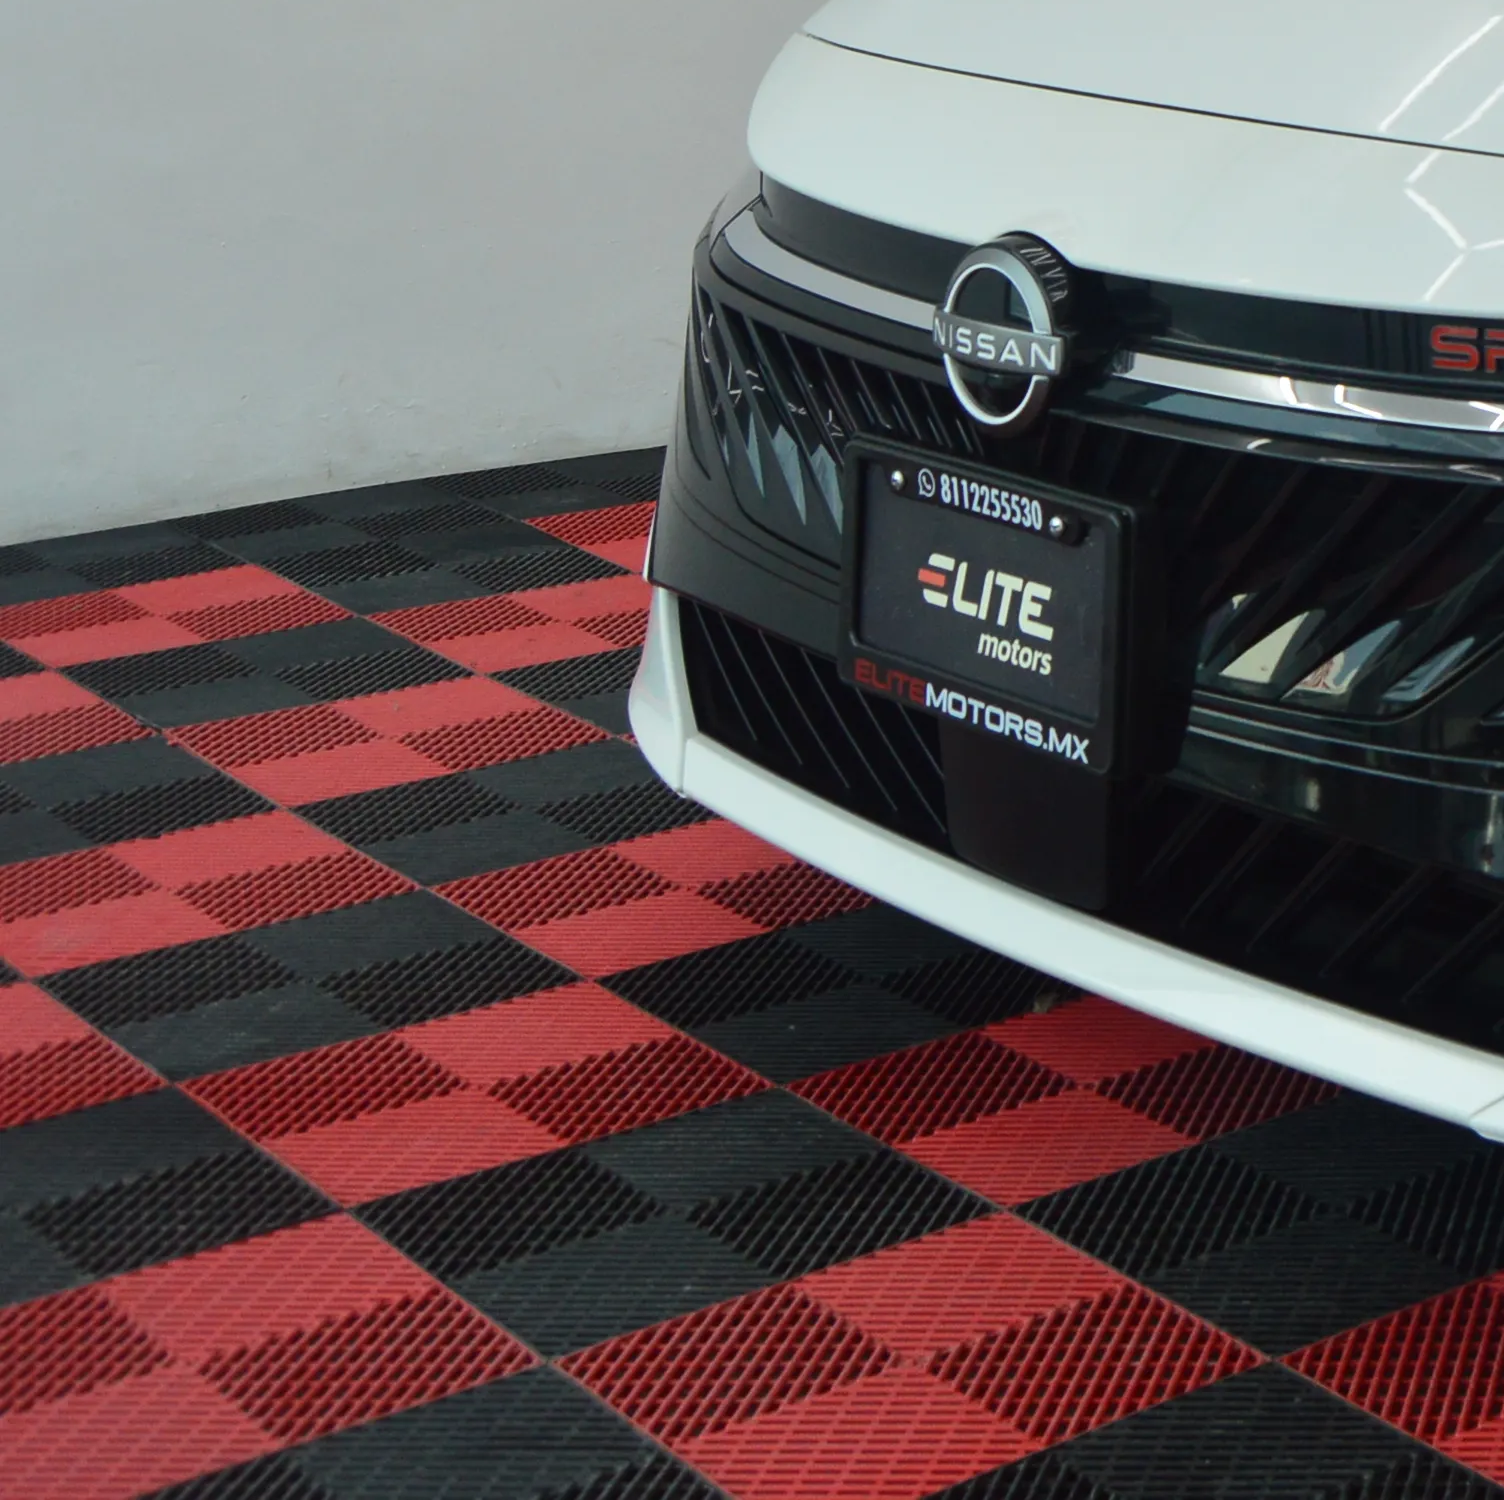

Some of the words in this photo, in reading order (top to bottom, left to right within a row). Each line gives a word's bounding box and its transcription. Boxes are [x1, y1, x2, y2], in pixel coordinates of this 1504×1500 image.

[933, 317, 1057, 371] NISSAN
[939, 473, 1043, 531] 8112255530
[918, 553, 1054, 641] ELITE
[977, 632, 1053, 676] motors
